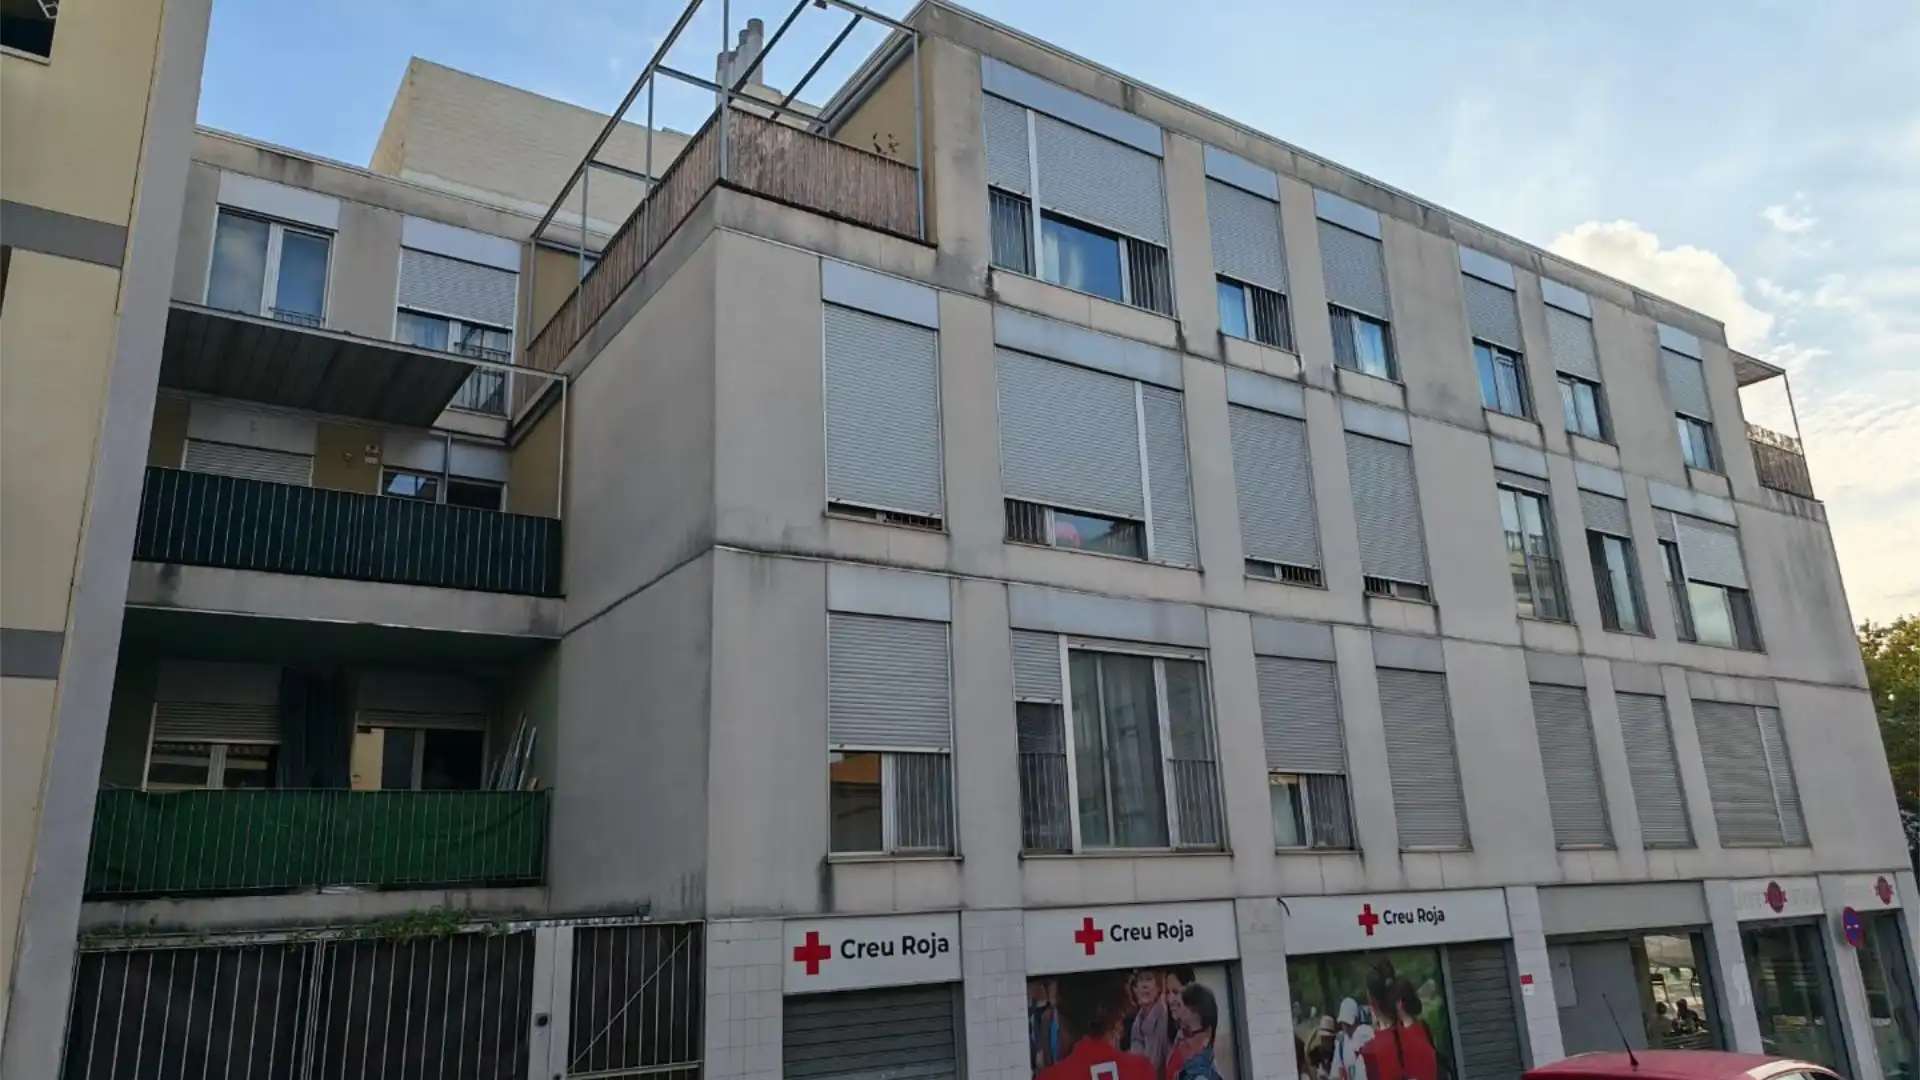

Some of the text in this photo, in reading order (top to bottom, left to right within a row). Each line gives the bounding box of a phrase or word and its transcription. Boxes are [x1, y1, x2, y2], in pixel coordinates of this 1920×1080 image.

[1382, 905, 1445, 926] Creu Roja
[1109, 919, 1194, 943] Creu Roja
[840, 932, 950, 960] Creu Roja
